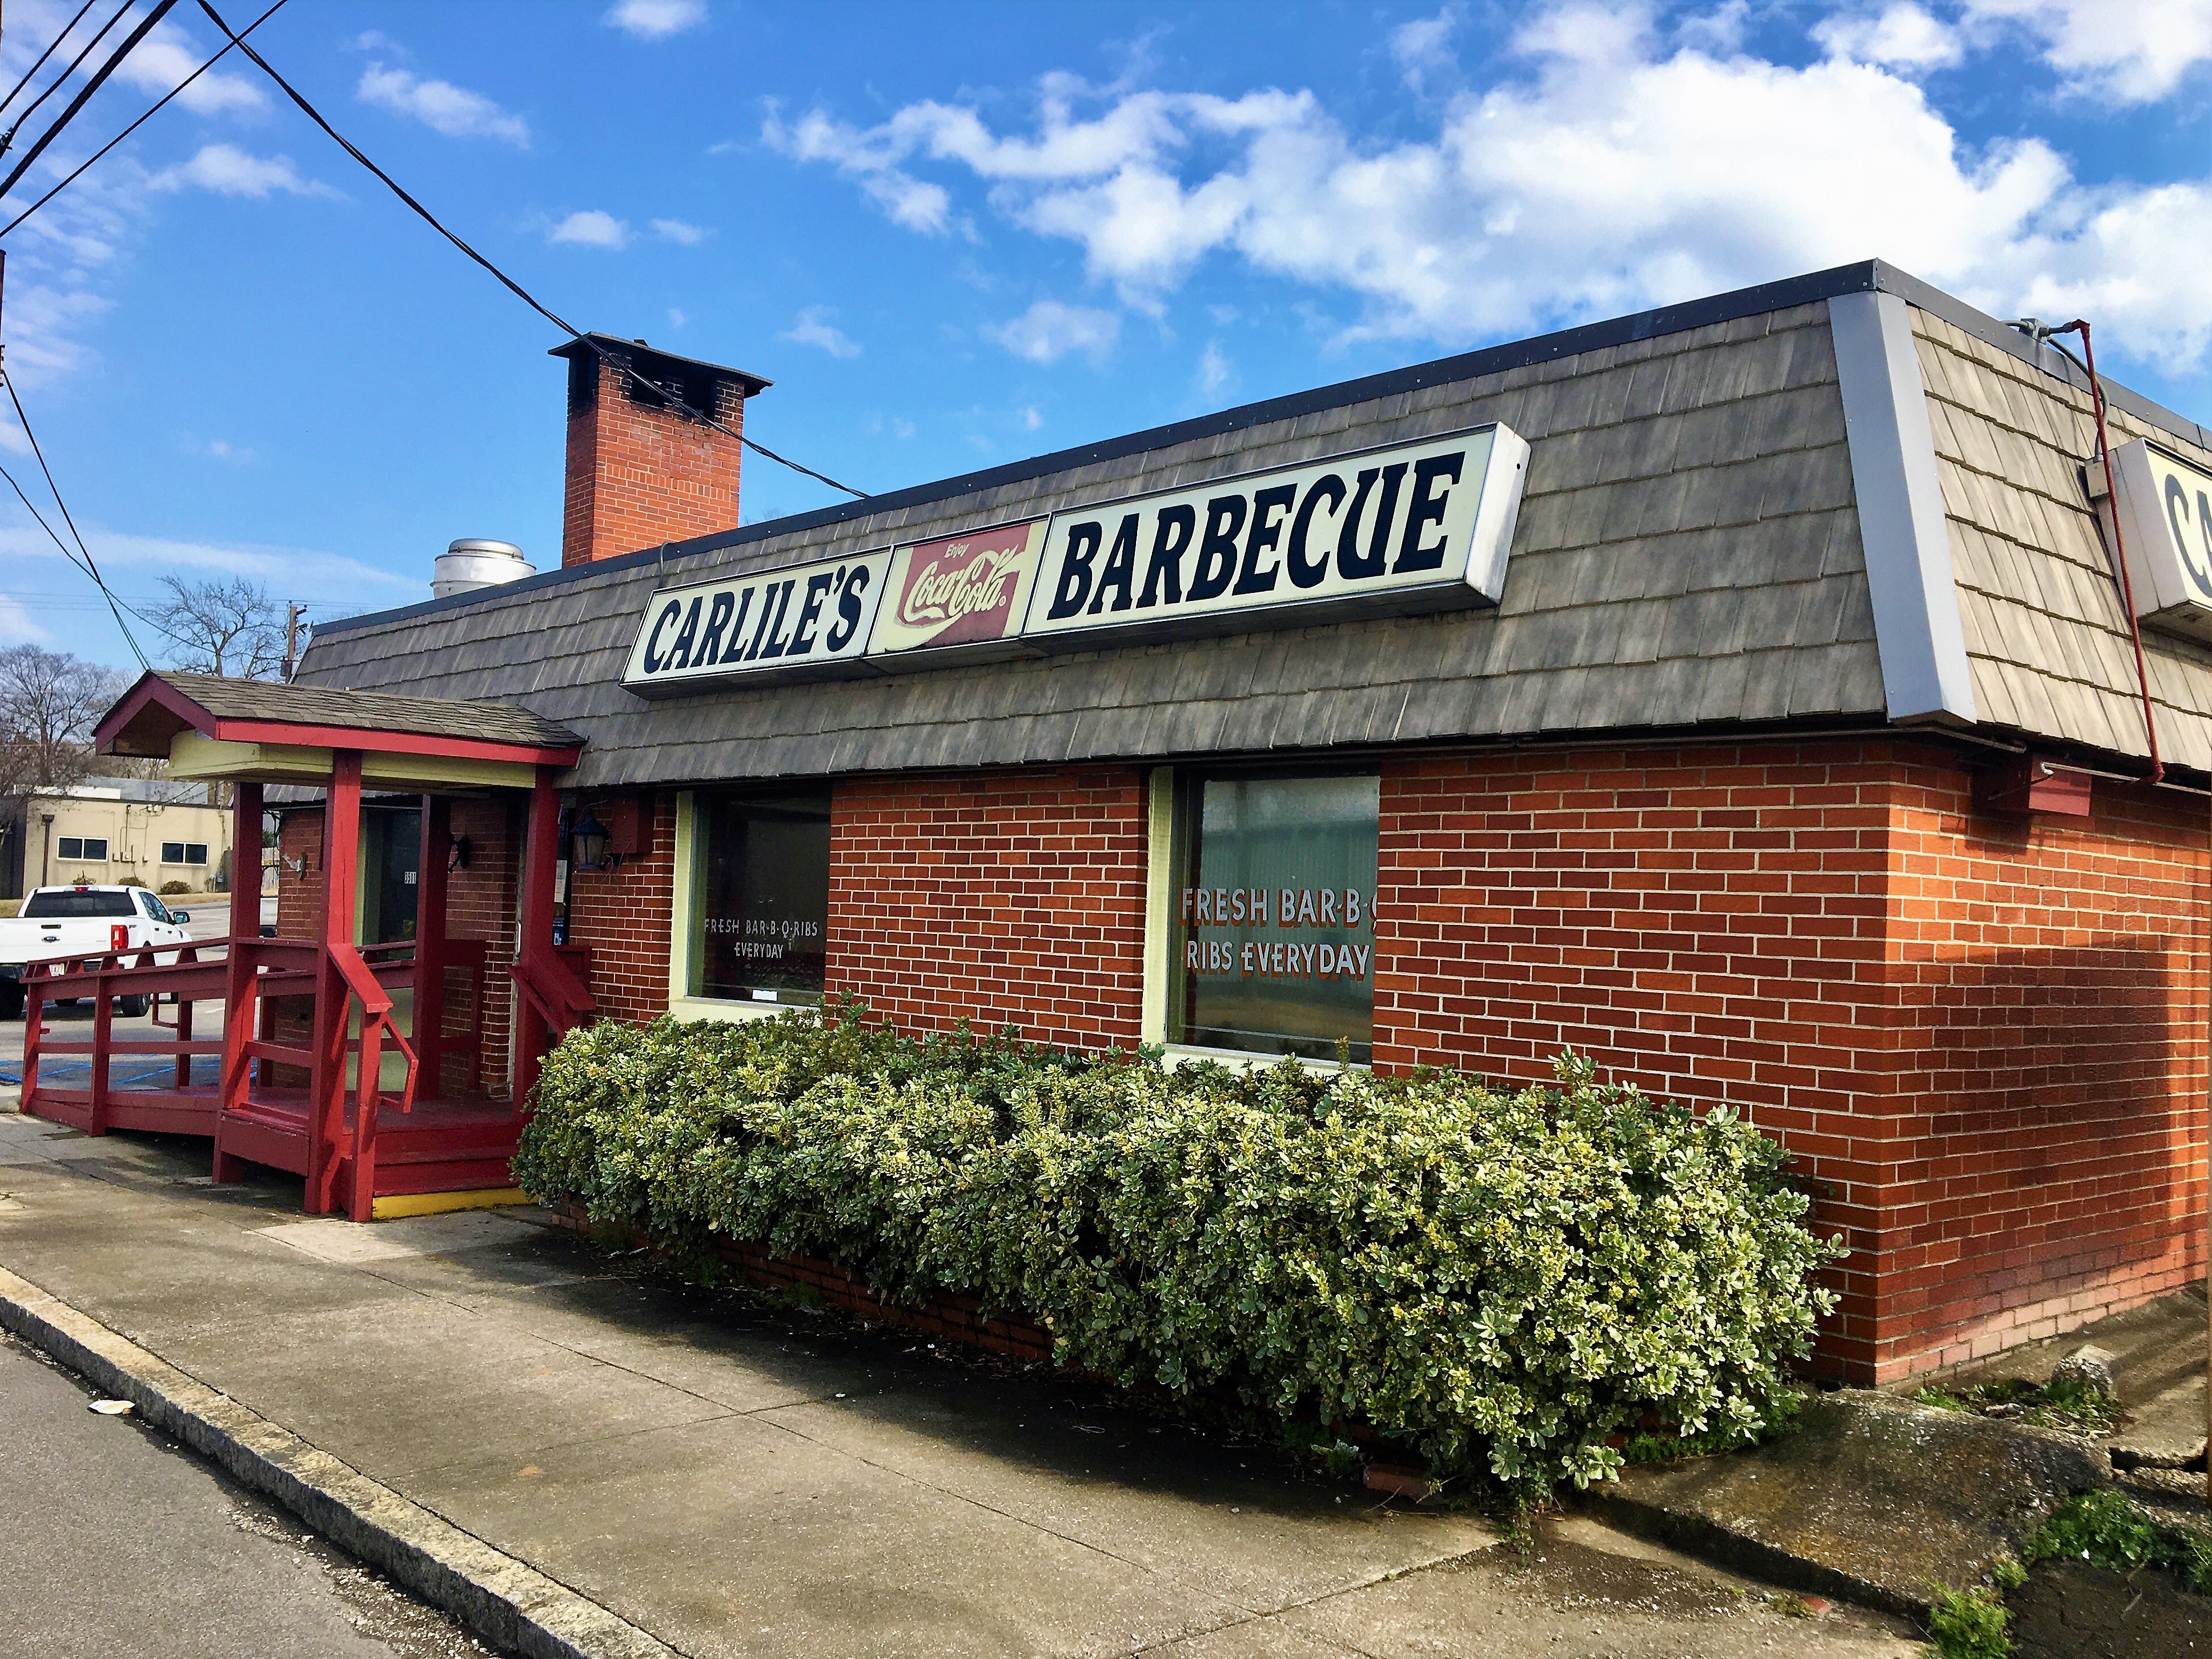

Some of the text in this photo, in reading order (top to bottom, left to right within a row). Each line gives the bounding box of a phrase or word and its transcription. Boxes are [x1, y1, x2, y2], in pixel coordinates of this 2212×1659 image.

[944, 543, 970, 559] Enjoy
[1047, 451, 1466, 620] BARBECUE
[904, 544, 1018, 622] Coca-Cola
[643, 564, 870, 674] CARLILE'S
[1180, 888, 1268, 924] FRESH
[704, 918, 740, 934] FRESH
[734, 942, 784, 959] EVERYDAY
[1186, 940, 1370, 979] RIBS EVERYDAY
